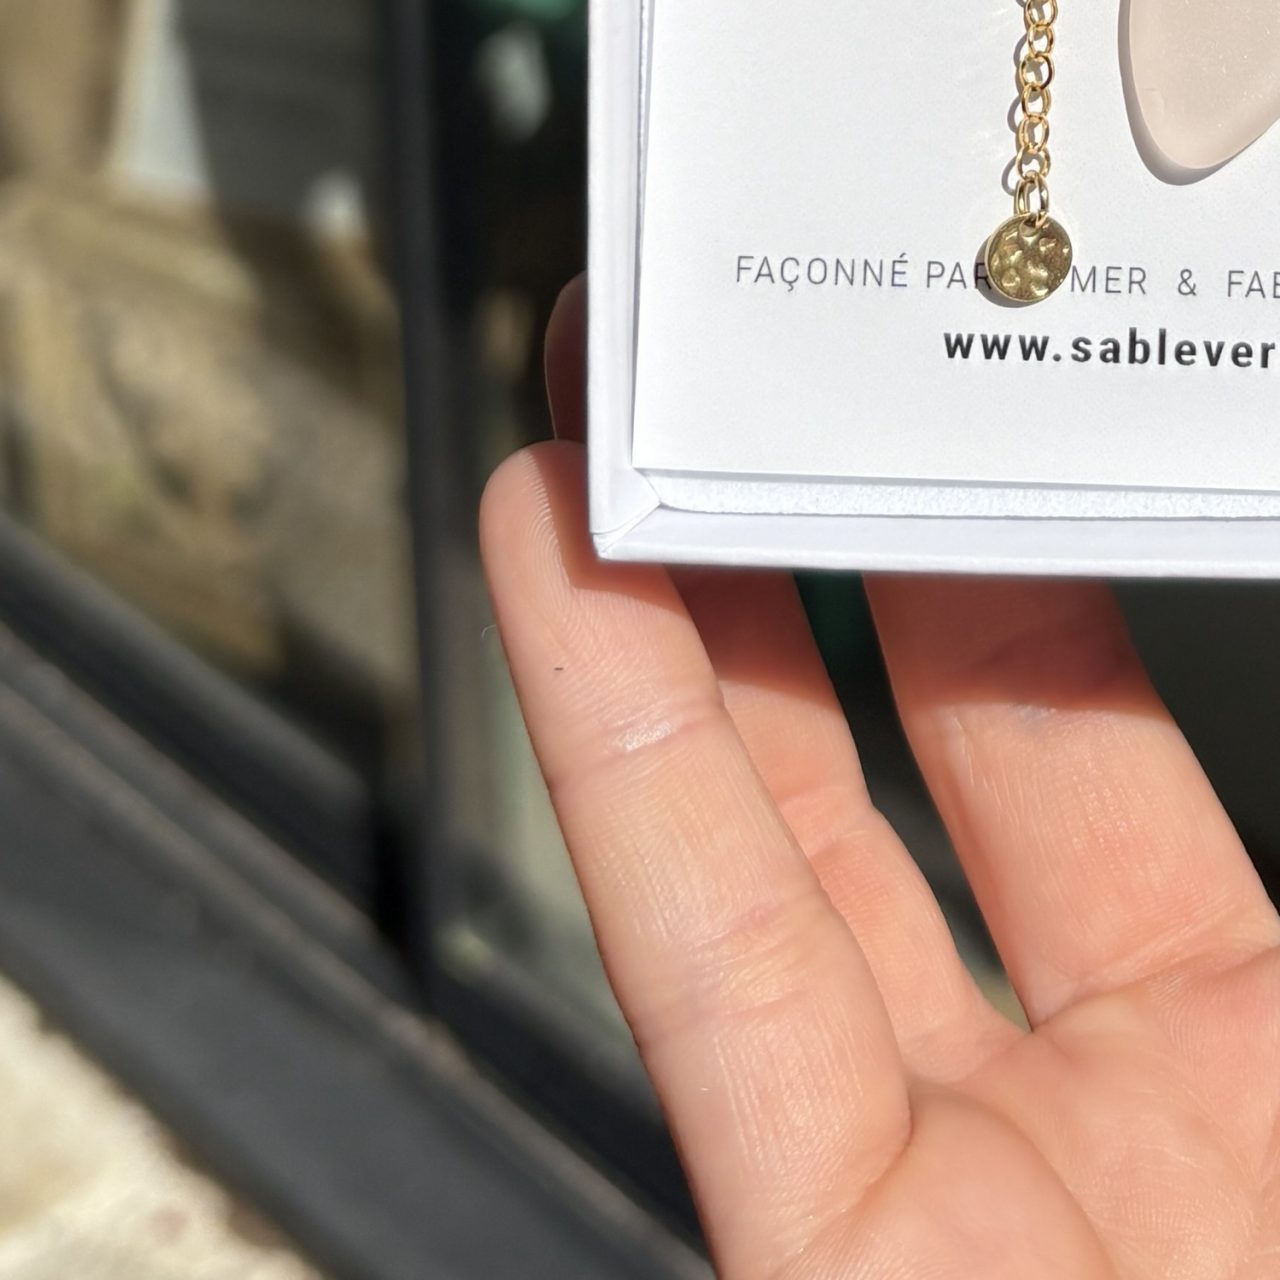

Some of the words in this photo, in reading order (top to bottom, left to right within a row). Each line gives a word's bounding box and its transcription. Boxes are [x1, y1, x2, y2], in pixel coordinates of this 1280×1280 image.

[736, 252, 909, 293] FAÇONNÉ
[925, 261, 991, 290] PAR
[1070, 265, 1148, 295] MER
[1177, 268, 1198, 297] &
